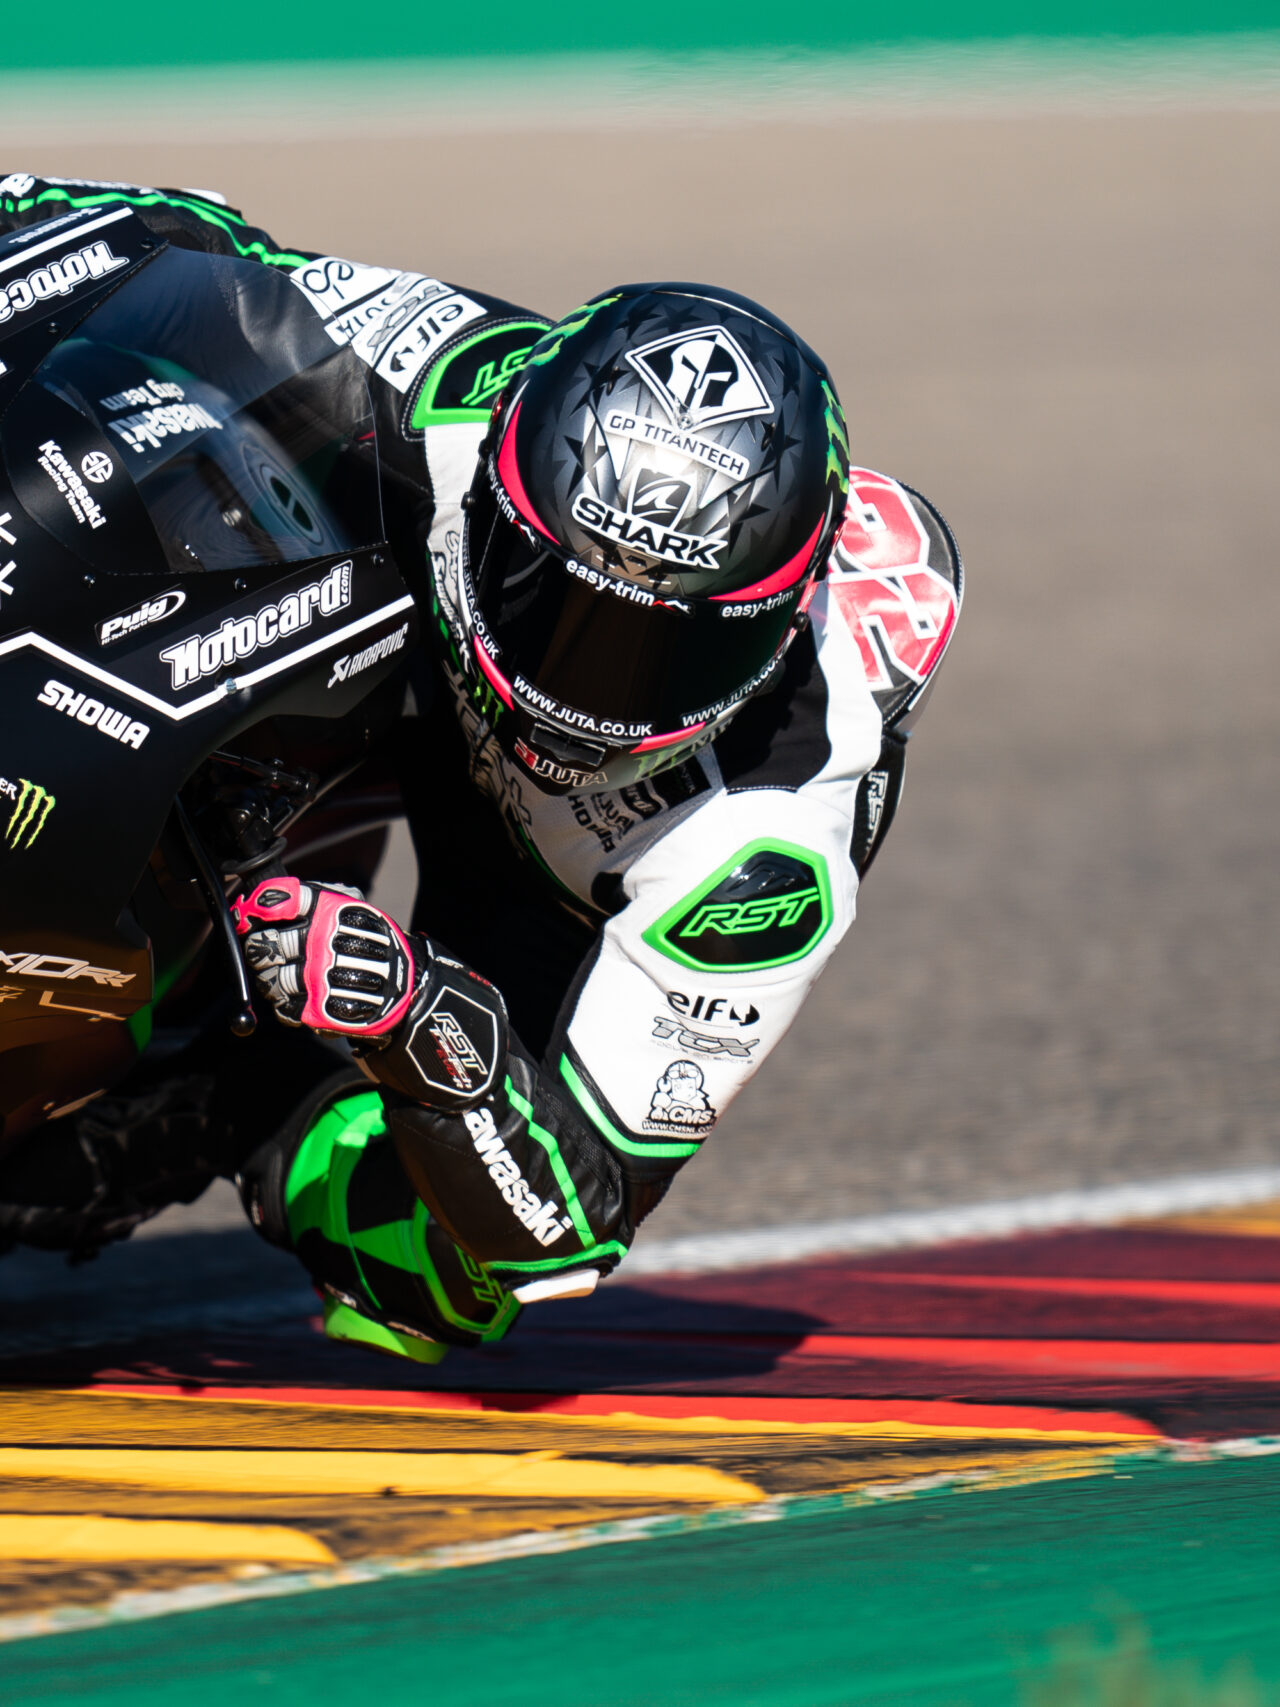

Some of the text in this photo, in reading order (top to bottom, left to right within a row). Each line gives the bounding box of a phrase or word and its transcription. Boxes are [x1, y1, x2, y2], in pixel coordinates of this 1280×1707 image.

[416, 304, 464, 352] elf
[461, 346, 534, 406] ST
[609, 415, 745, 476] GP TITANTECH
[37, 455, 87, 524] Racing Team
[38, 439, 107, 530] Kawasaki
[573, 493, 727, 569] SHARK
[565, 557, 656, 607] easy-trim
[721, 589, 795, 619] easy-trim
[101, 598, 168, 639] Puig
[160, 565, 342, 690] Motocard
[37, 679, 151, 750] SHOWA
[513, 675, 653, 737] WWW.JUTA.CO.UK
[681, 645, 786, 728] WWW.JUTA.CO.
[535, 759, 608, 787] JUTA
[569, 795, 617, 853] HOWA
[679, 887, 820, 937] RST
[651, 1015, 761, 1057] TCX
[666, 990, 728, 1022] elf
[431, 1012, 489, 1076] RST
[667, 1105, 713, 1125] CMS
[463, 1107, 573, 1248] awasaki
[455, 1243, 508, 1310] ST
